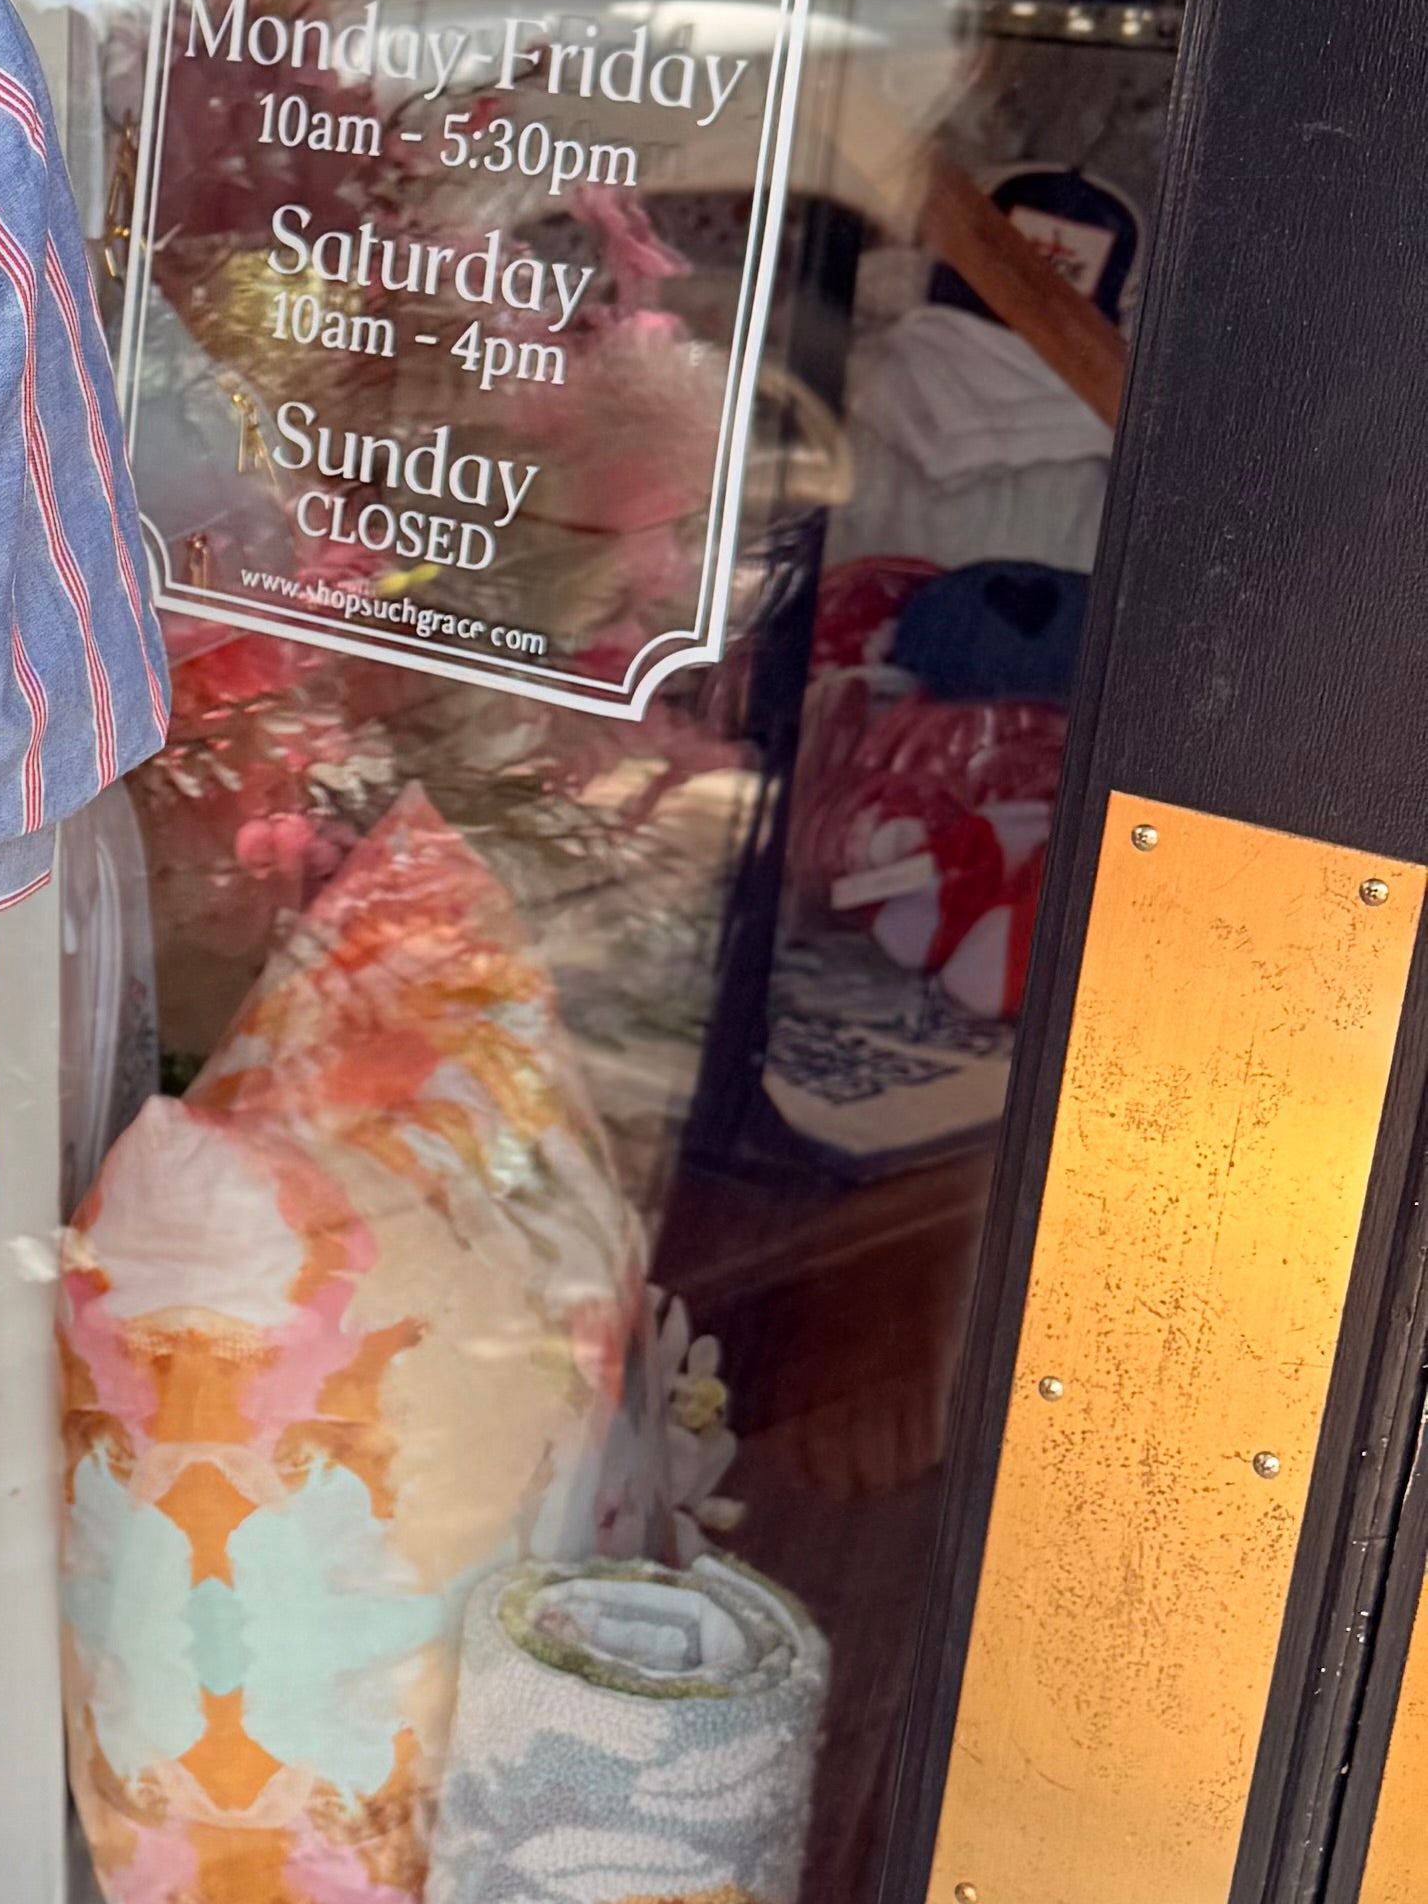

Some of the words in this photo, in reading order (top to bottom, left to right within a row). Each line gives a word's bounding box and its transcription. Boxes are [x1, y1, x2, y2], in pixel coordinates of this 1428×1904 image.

[257, 93, 381, 156] 10am
[440, 113, 637, 195] 5:30pm
[268, 204, 595, 332] Saturday
[273, 291, 394, 357] 10am
[451, 321, 565, 390] 4pm
[273, 402, 540, 527] Sunday
[297, 492, 495, 571] CLOSED
[241, 569, 547, 654] www.shopsuchgracecom
